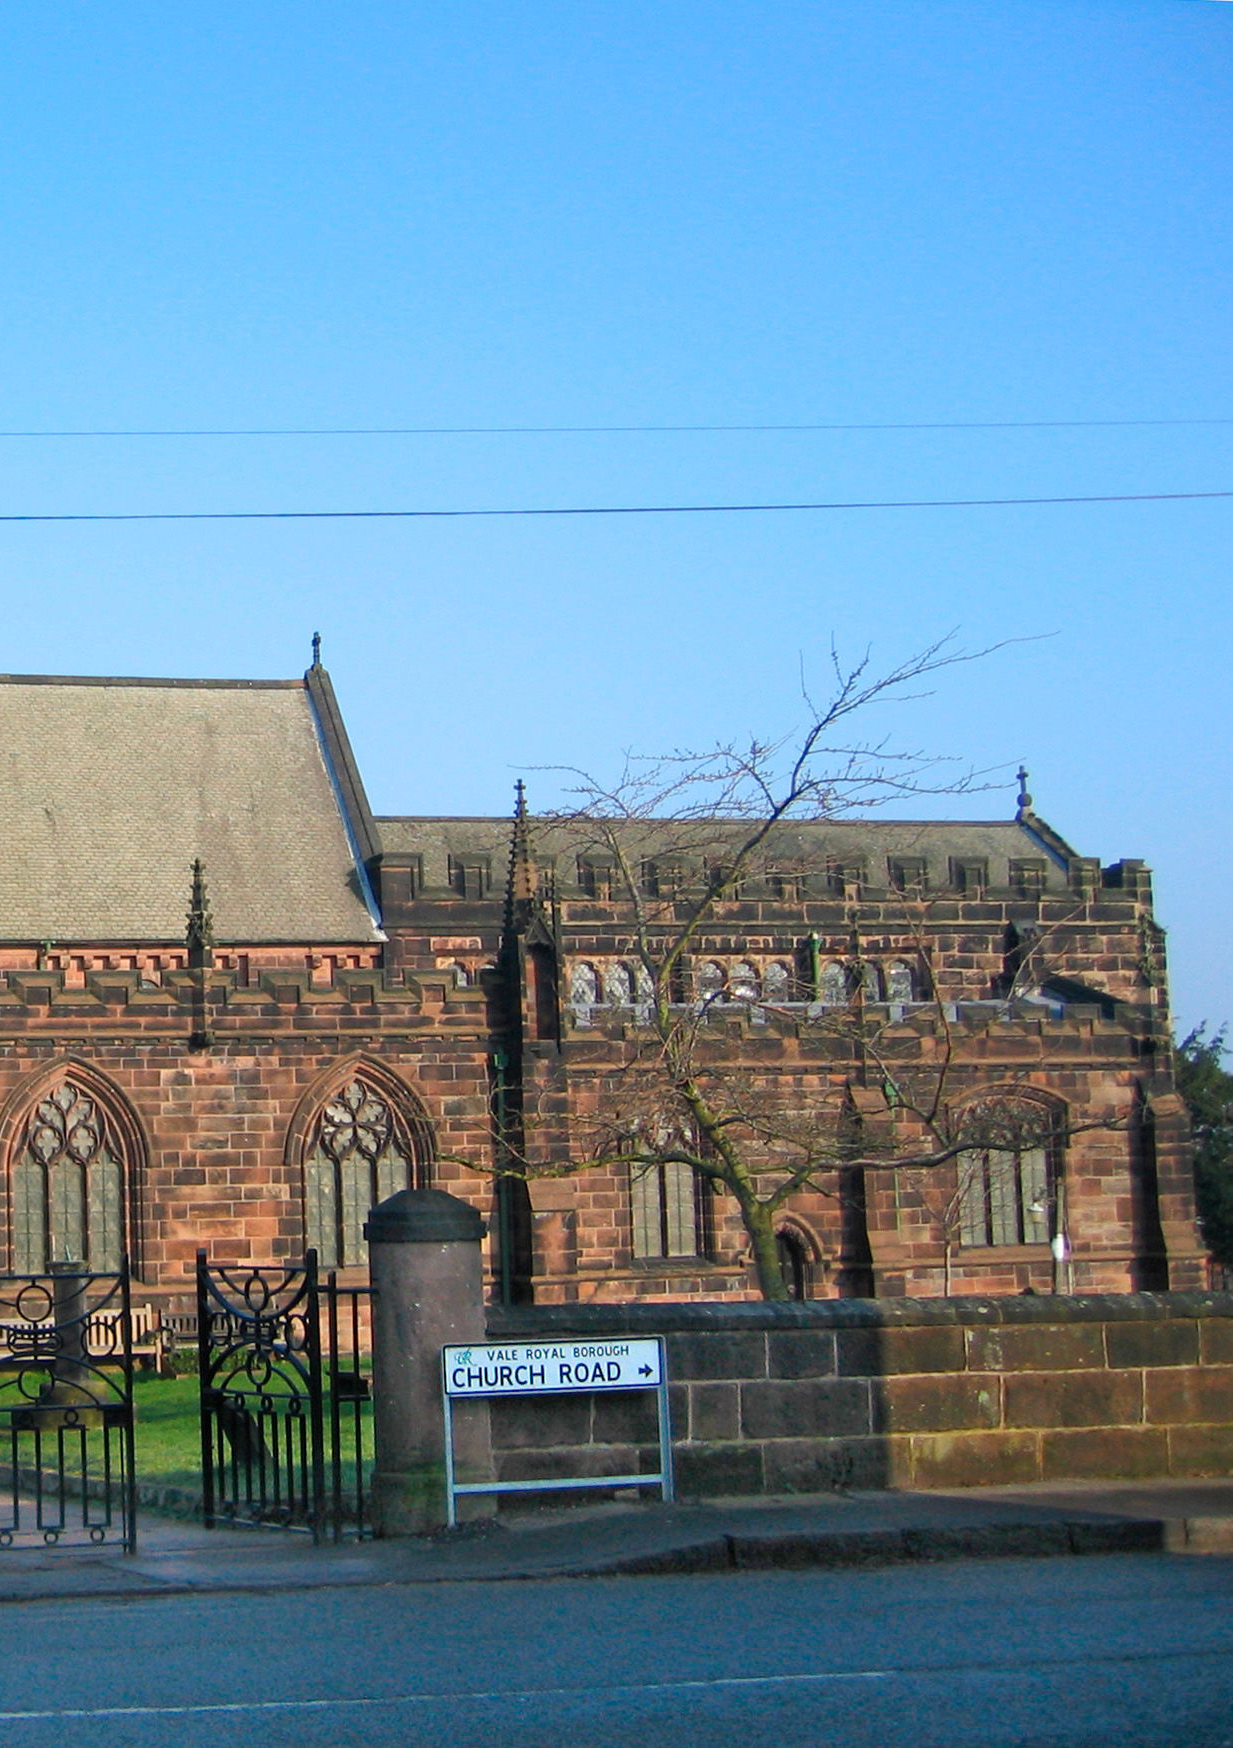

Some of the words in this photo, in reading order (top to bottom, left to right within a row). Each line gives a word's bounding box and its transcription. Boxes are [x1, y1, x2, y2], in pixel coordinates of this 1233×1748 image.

[487, 1350, 518, 1361] VALE
[526, 1347, 566, 1360] ROYAL
[573, 1345, 629, 1358] BOROUGH
[452, 1364, 545, 1388] CHURCH
[559, 1361, 621, 1384] ROAD
